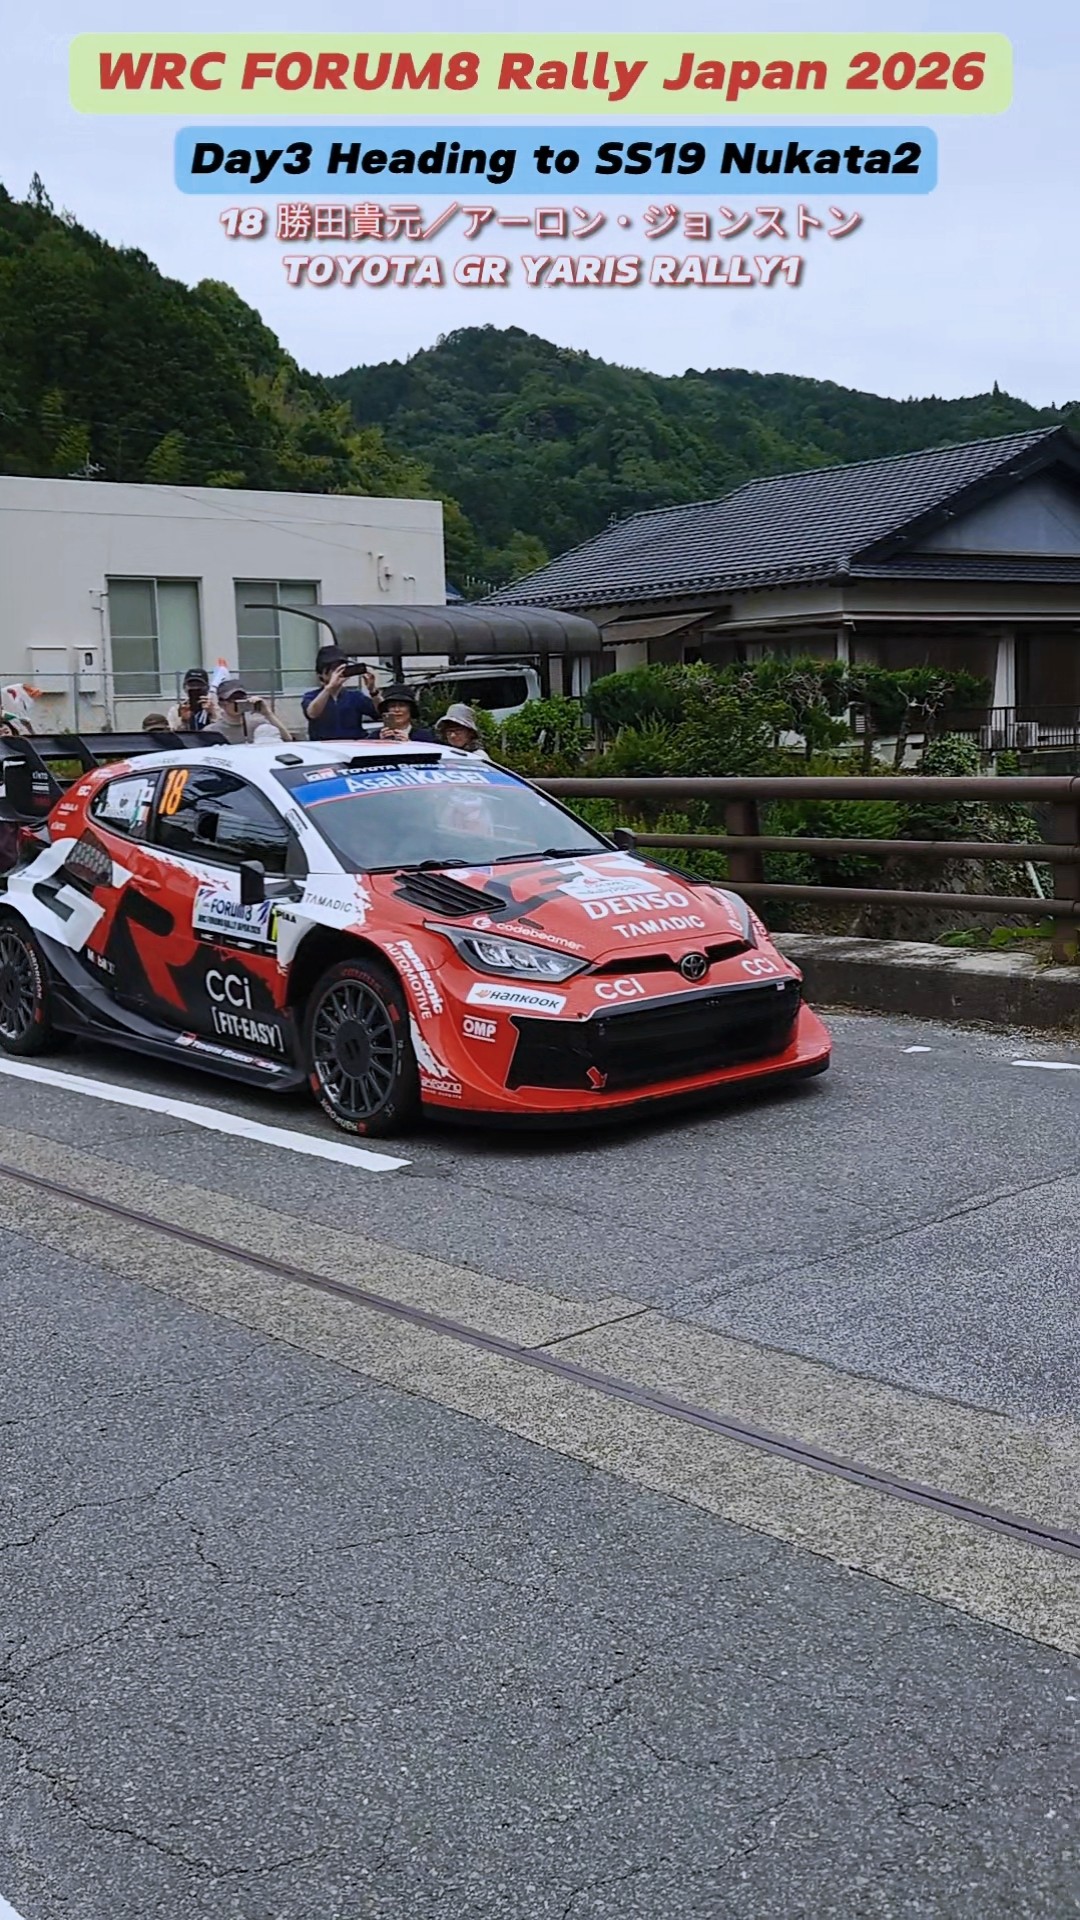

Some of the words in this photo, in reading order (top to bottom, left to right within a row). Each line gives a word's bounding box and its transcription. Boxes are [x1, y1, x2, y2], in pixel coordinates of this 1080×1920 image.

[337, 764, 396, 776] TOYOTA
[157, 768, 190, 816] 18
[305, 892, 352, 913] TAMADIC
[580, 891, 690, 921] DENSO
[496, 921, 587, 951] codebeamer
[612, 914, 706, 939] TAMADIC
[381, 942, 433, 1020] AUTOMOTIVE
[394, 939, 444, 1016] Panasonic
[594, 977, 646, 1000] CCI
[462, 1018, 497, 1039] OMP
